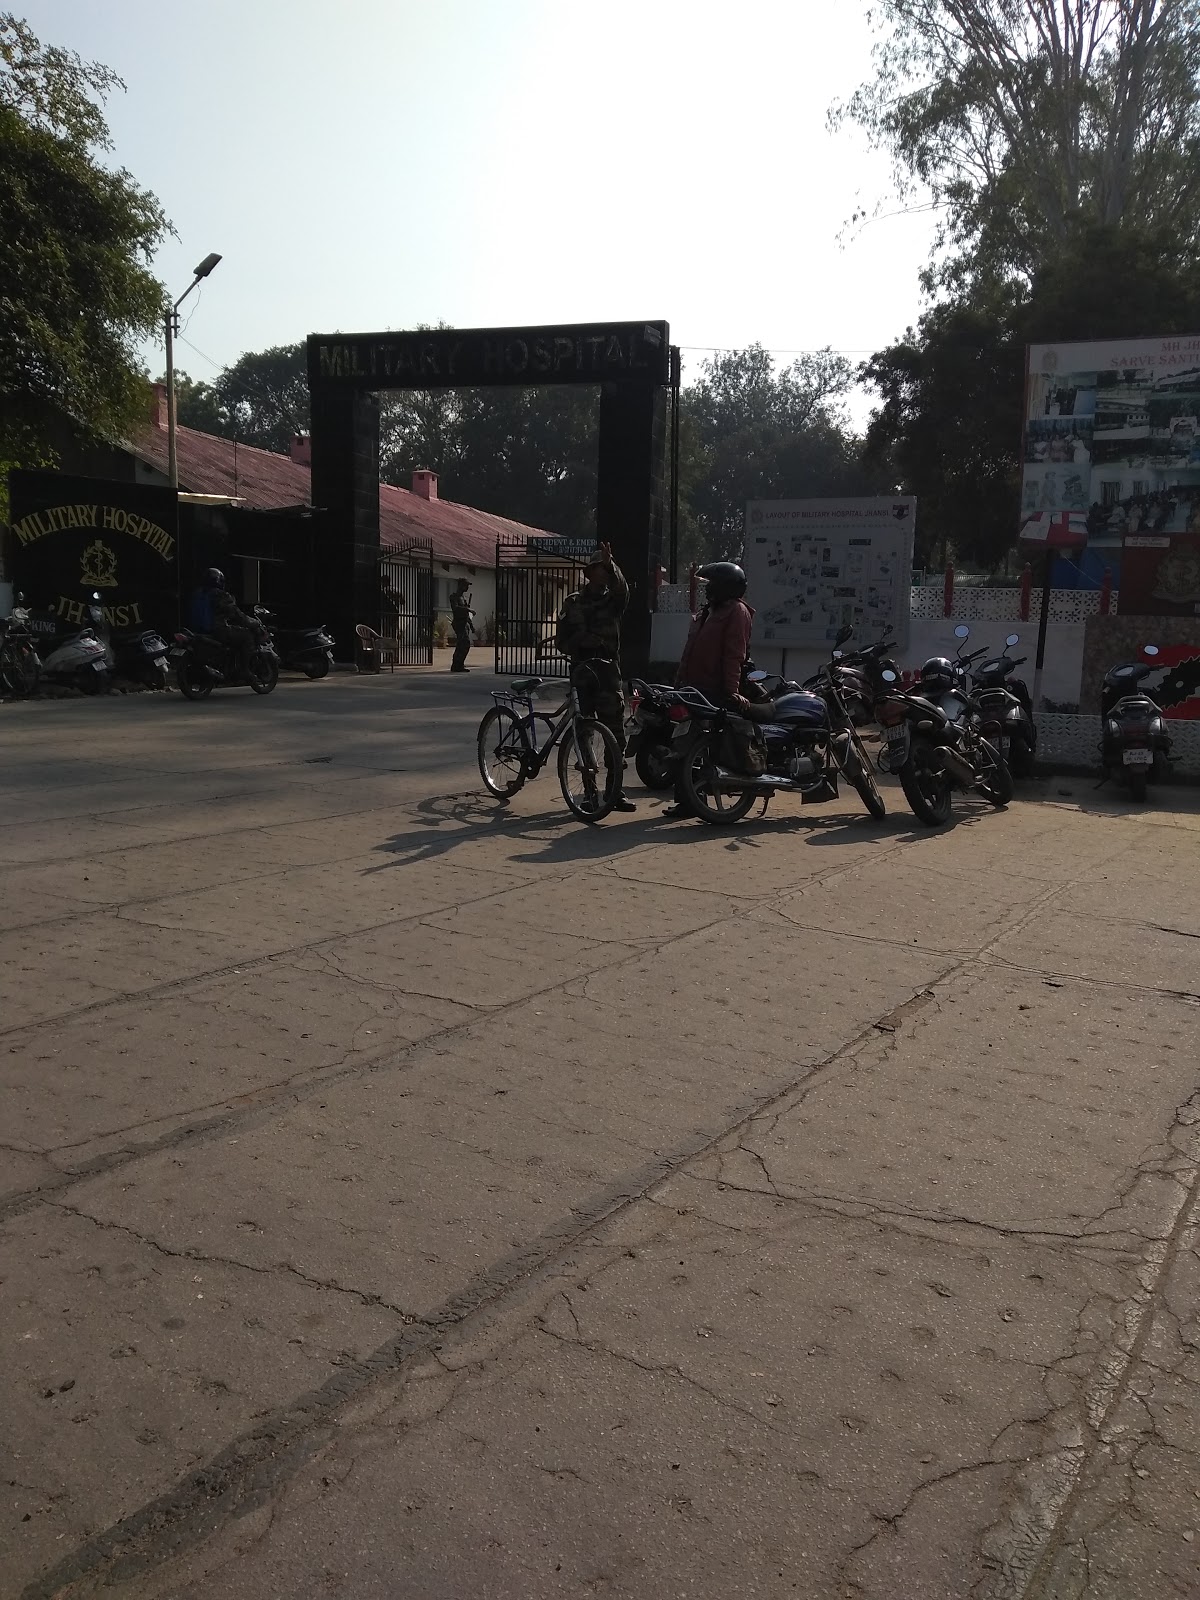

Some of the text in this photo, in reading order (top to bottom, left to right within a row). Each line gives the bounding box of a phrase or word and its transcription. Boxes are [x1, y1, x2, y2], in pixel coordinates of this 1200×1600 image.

[319, 334, 648, 377] MILITARY HOSPITAL
[1161, 342, 1180, 351] MH
[1111, 355, 1155, 367] SARVE
[765, 509, 889, 519] LAYOUT OF MILITARY HOSPITAL JHANSI
[11, 504, 176, 561] MILITARY HOSPITAL
[56, 595, 144, 627] JHNSI
